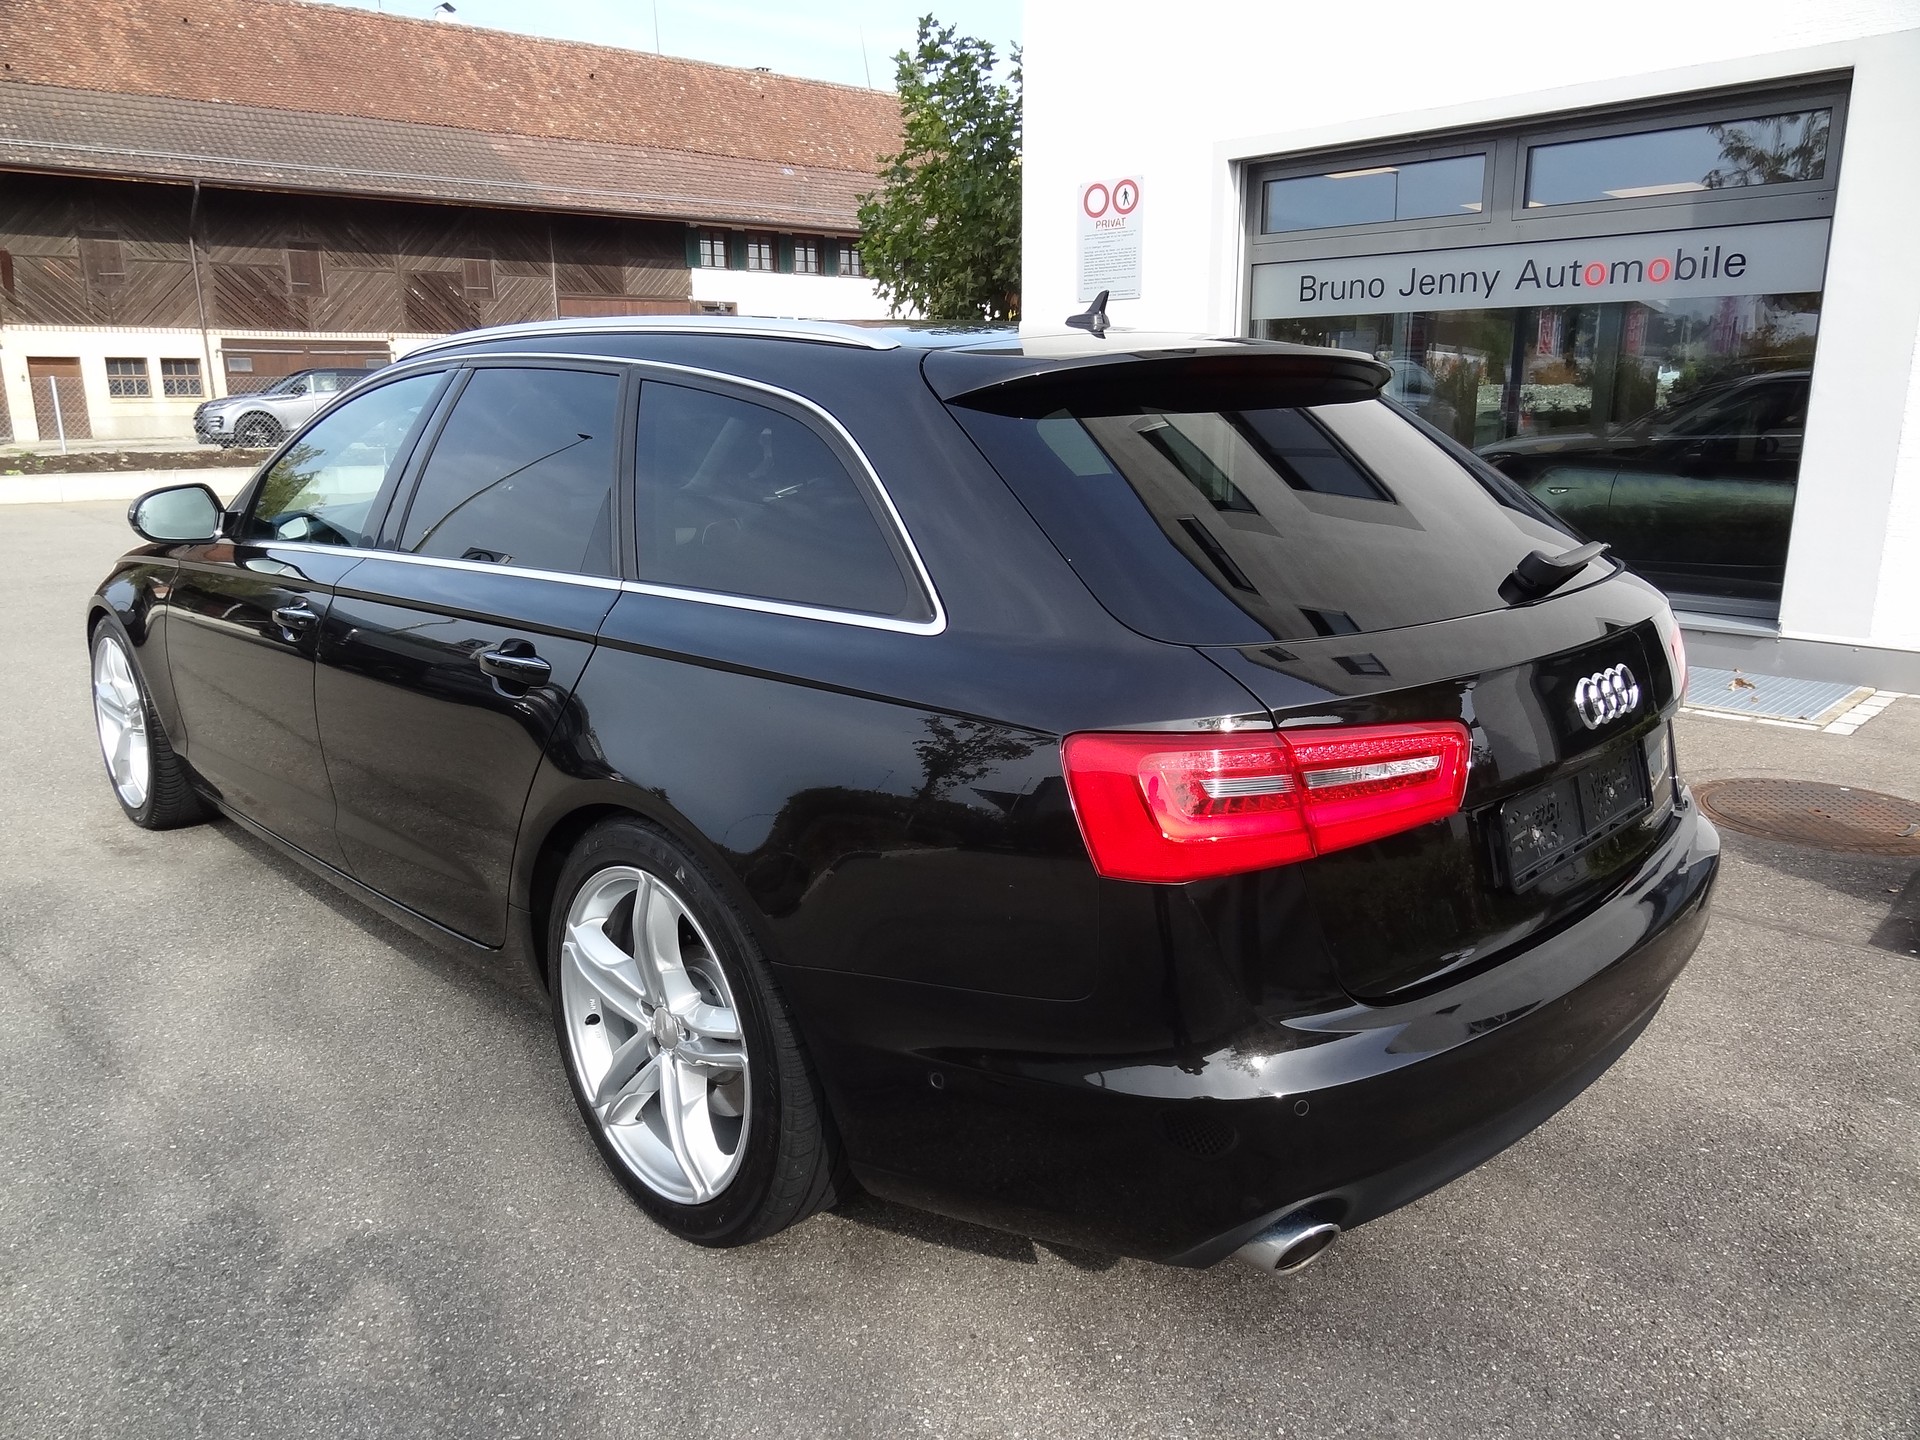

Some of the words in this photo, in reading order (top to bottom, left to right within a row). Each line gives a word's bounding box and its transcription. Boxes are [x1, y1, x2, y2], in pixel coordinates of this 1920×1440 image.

[1095, 217, 1126, 229] PRIVAT
[1299, 275, 1385, 302] Bruno
[1398, 267, 1501, 299] Jenny
[1514, 245, 1747, 290] Automobile
